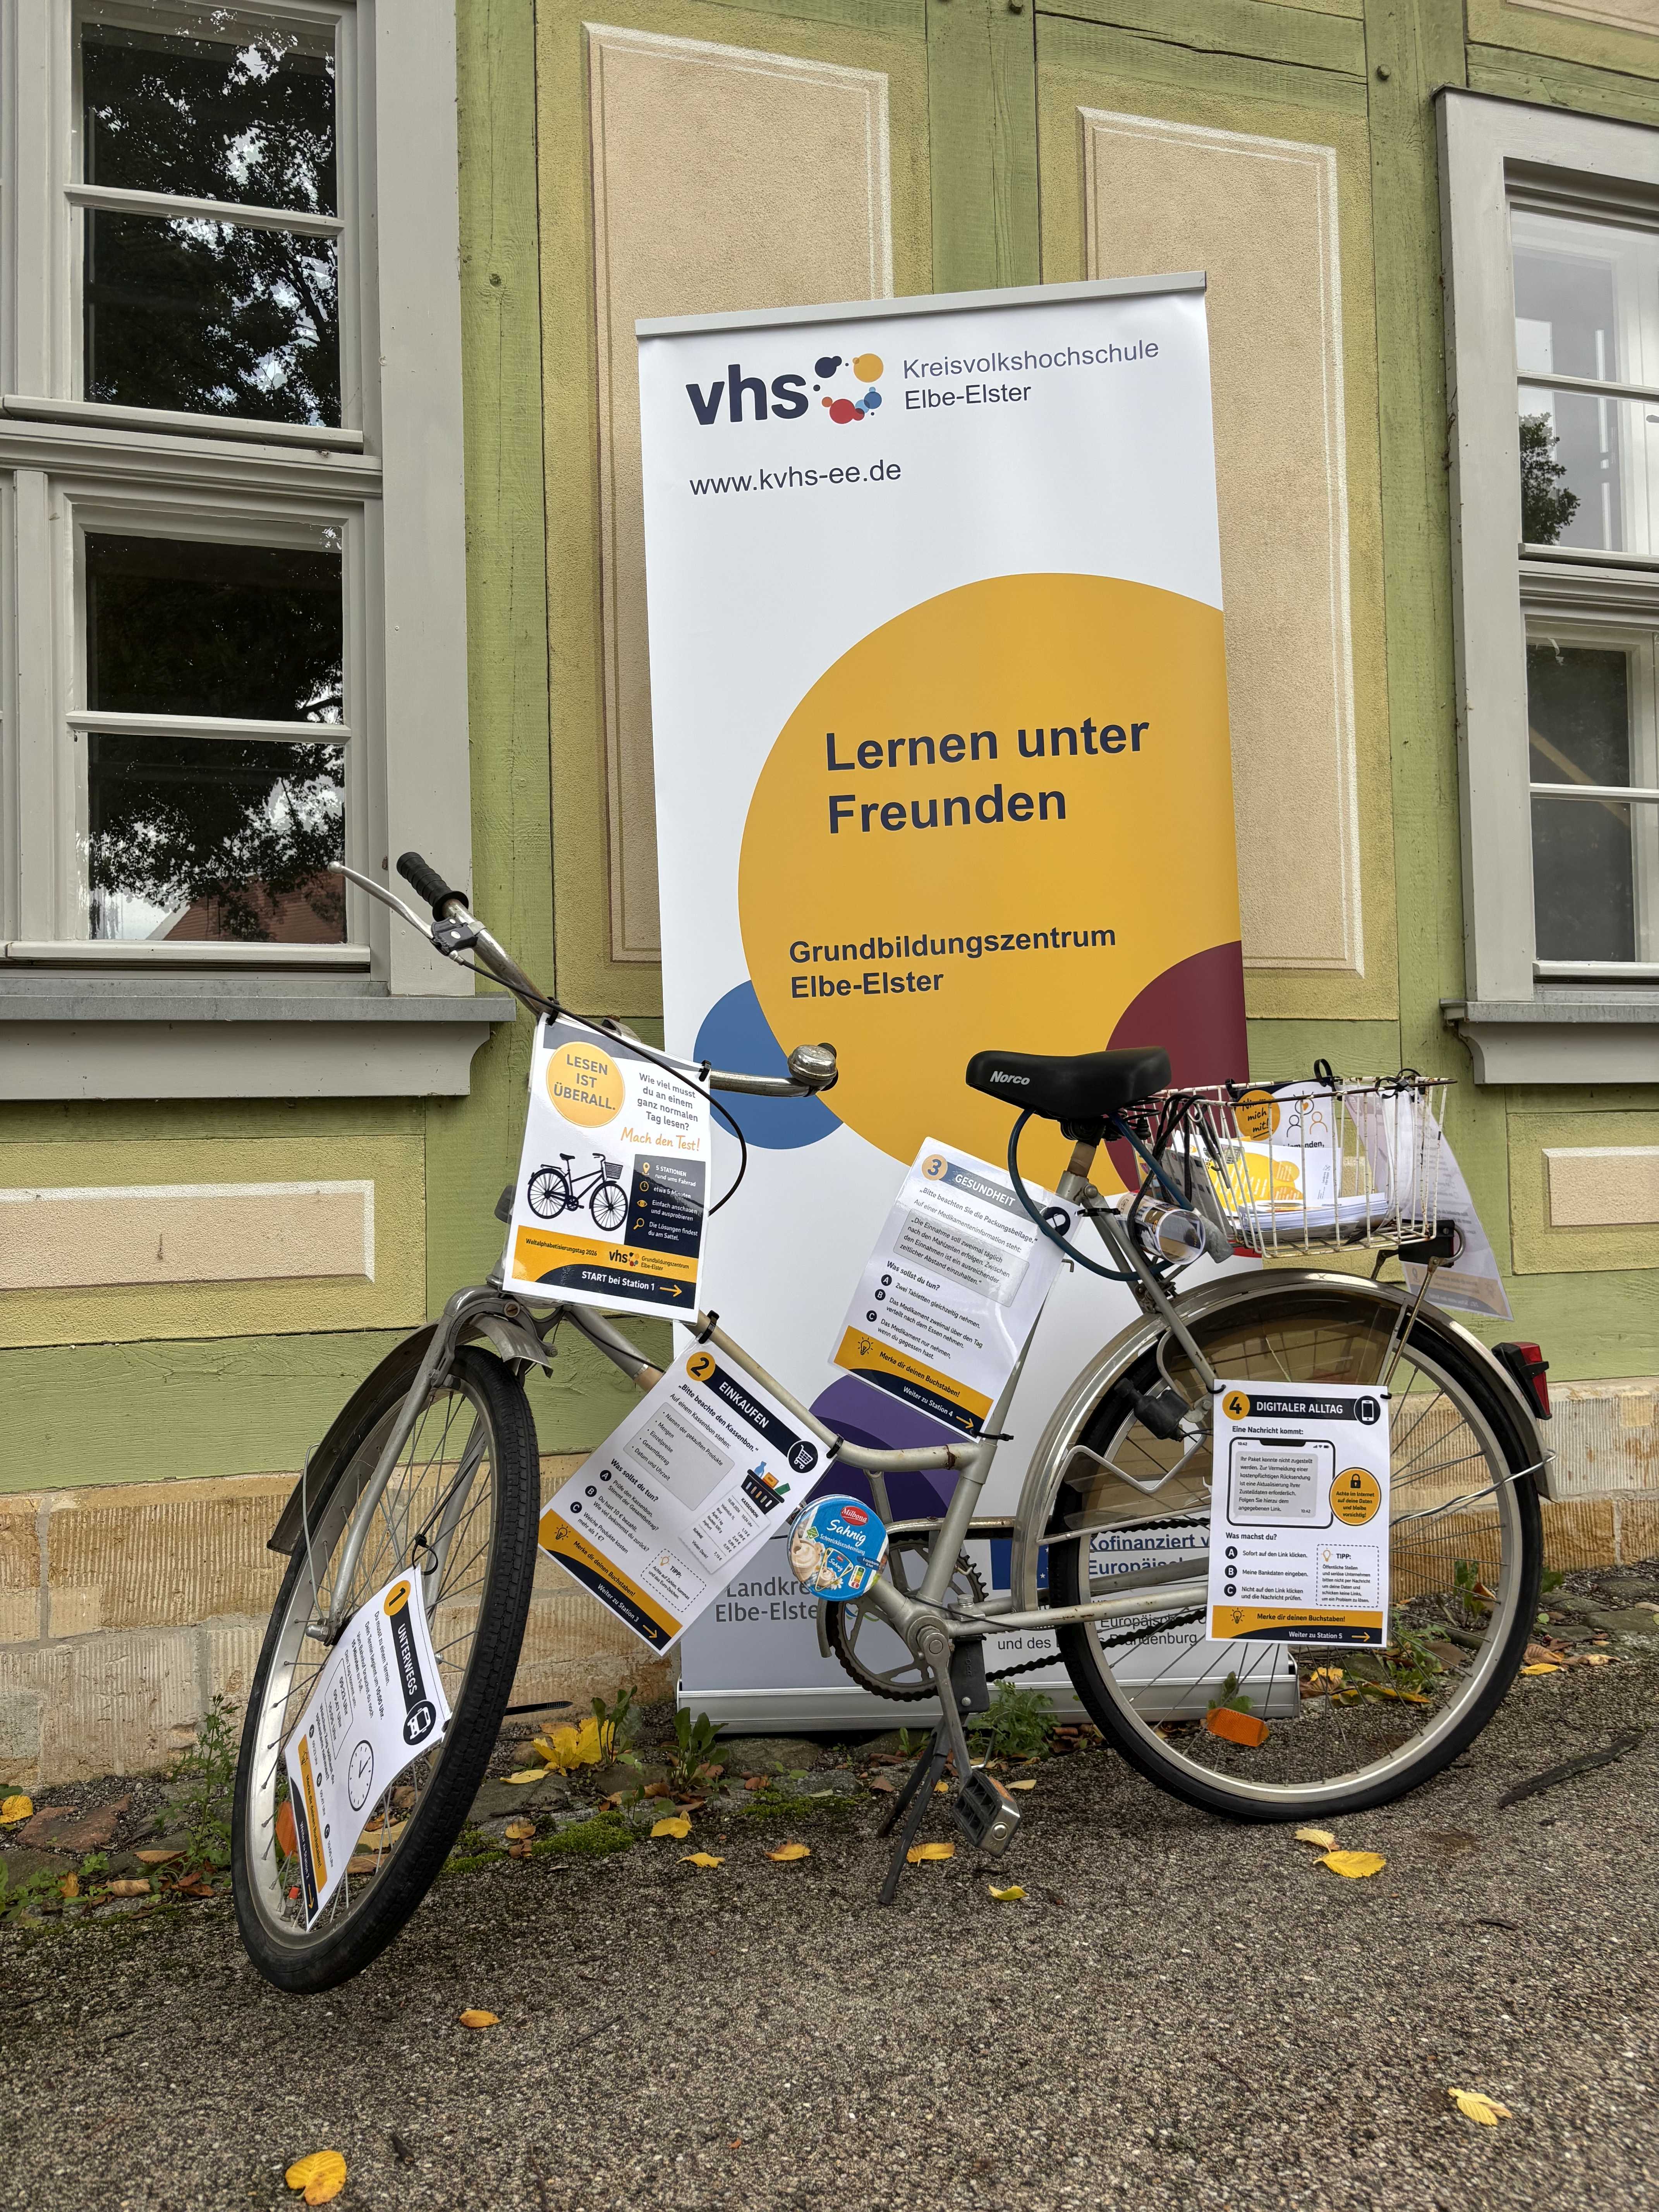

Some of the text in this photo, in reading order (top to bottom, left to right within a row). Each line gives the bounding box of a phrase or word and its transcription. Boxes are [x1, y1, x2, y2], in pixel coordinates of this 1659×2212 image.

[904, 340, 1158, 378] Kreisvolkshochschule
[685, 364, 808, 425] vhs
[905, 384, 1031, 409] Elbe-Elster
[689, 459, 901, 495] www.kvhs-ee.de
[826, 717, 1149, 771] Lernen unter
[829, 783, 1065, 833] Freunden
[790, 927, 1115, 963] Grundbildungszentrum
[792, 971, 944, 998] Elbe-Elster
[567, 1053, 608, 1075] LESEN
[576, 1073, 597, 1088] IST
[639, 1072, 696, 1098] Wie viel musst
[989, 1070, 1030, 1085] Norco
[553, 1081, 615, 1110] ÜBERALL.
[642, 1086, 692, 1109] du an einem
[637, 1098, 698, 1122] ganz normalen
[1247, 1107, 1267, 1121] mich
[646, 1111, 689, 1131] Tag lesen?
[1252, 1118, 1269, 1132] mit!
[620, 1127, 700, 1151] Mach den Test!
[660, 1166, 686, 1177] STATIONEN
[927, 1158, 942, 1176] 3
[678, 1178, 696, 1187] Fahrrad
[954, 1173, 1016, 1207] GESUNDHEIT
[671, 1190, 691, 1199] Minuten
[937, 1194, 963, 1210] beachten
[963, 1206, 973, 1214] Sie
[652, 1199, 698, 1214] Einfach anschauen
[661, 1211, 693, 1221] ausprobieren
[658, 1223, 681, 1233] Lösungen
[682, 1227, 698, 1236] findest
[663, 1232, 679, 1240] Sattel.
[914, 1199, 1022, 1253] Auf einer Medikamenteninformation steht:
[526, 1238, 585, 1255] Weltalphabetisierungstag
[609, 1250, 628, 1263] vhs
[641, 1255, 689, 1269] Grundbildungszentrum
[641, 1262, 663, 1271] Elbe-Elster
[581, 1271, 654, 1291] START bei Station 1
[887, 1260, 940, 1291] Was sollst du tun?
[895, 1282, 980, 1329] Zwei Tabletten gleichzeitig nehmen.
[690, 1357, 709, 1377] 2
[879, 1351, 896, 1364] Merke
[905, 1365, 925, 1379] deinen
[925, 1375, 960, 1397] Buchstaben!
[694, 1395, 716, 1416] beachte
[715, 1415, 726, 1426] den
[719, 1381, 769, 1428] EINKAUFEN
[1229, 1396, 1242, 1414] 4
[1256, 1401, 1343, 1413] DIGITALER ALLTAG
[669, 1393, 731, 1449] Auf einem Kassenbon stehen:
[611, 1458, 658, 1502] Was sollst du tun?
[740, 1497, 759, 1518] KASSENBON
[841, 1508, 867, 1523] Milbona
[826, 1519, 866, 1547] Sahnig
[819, 1534, 866, 1555] Schmelzkäsezubereitung
[573, 1540, 587, 1555] Merke
[593, 1559, 609, 1573] deinen
[608, 1571, 635, 1597] Buchstaben!
[828, 1558, 843, 1572] Sahnig
[388, 1587, 405, 1607] 1
[598, 1583, 613, 1599] Weiter
[618, 1602, 635, 1619] Station
[374, 1611, 380, 1621] Du
[378, 1637, 383, 1646] zu
[998, 1637, 1051, 1649] und des
[398, 1623, 417, 1695] UNTERWEGS
[374, 1676, 378, 1687] um
